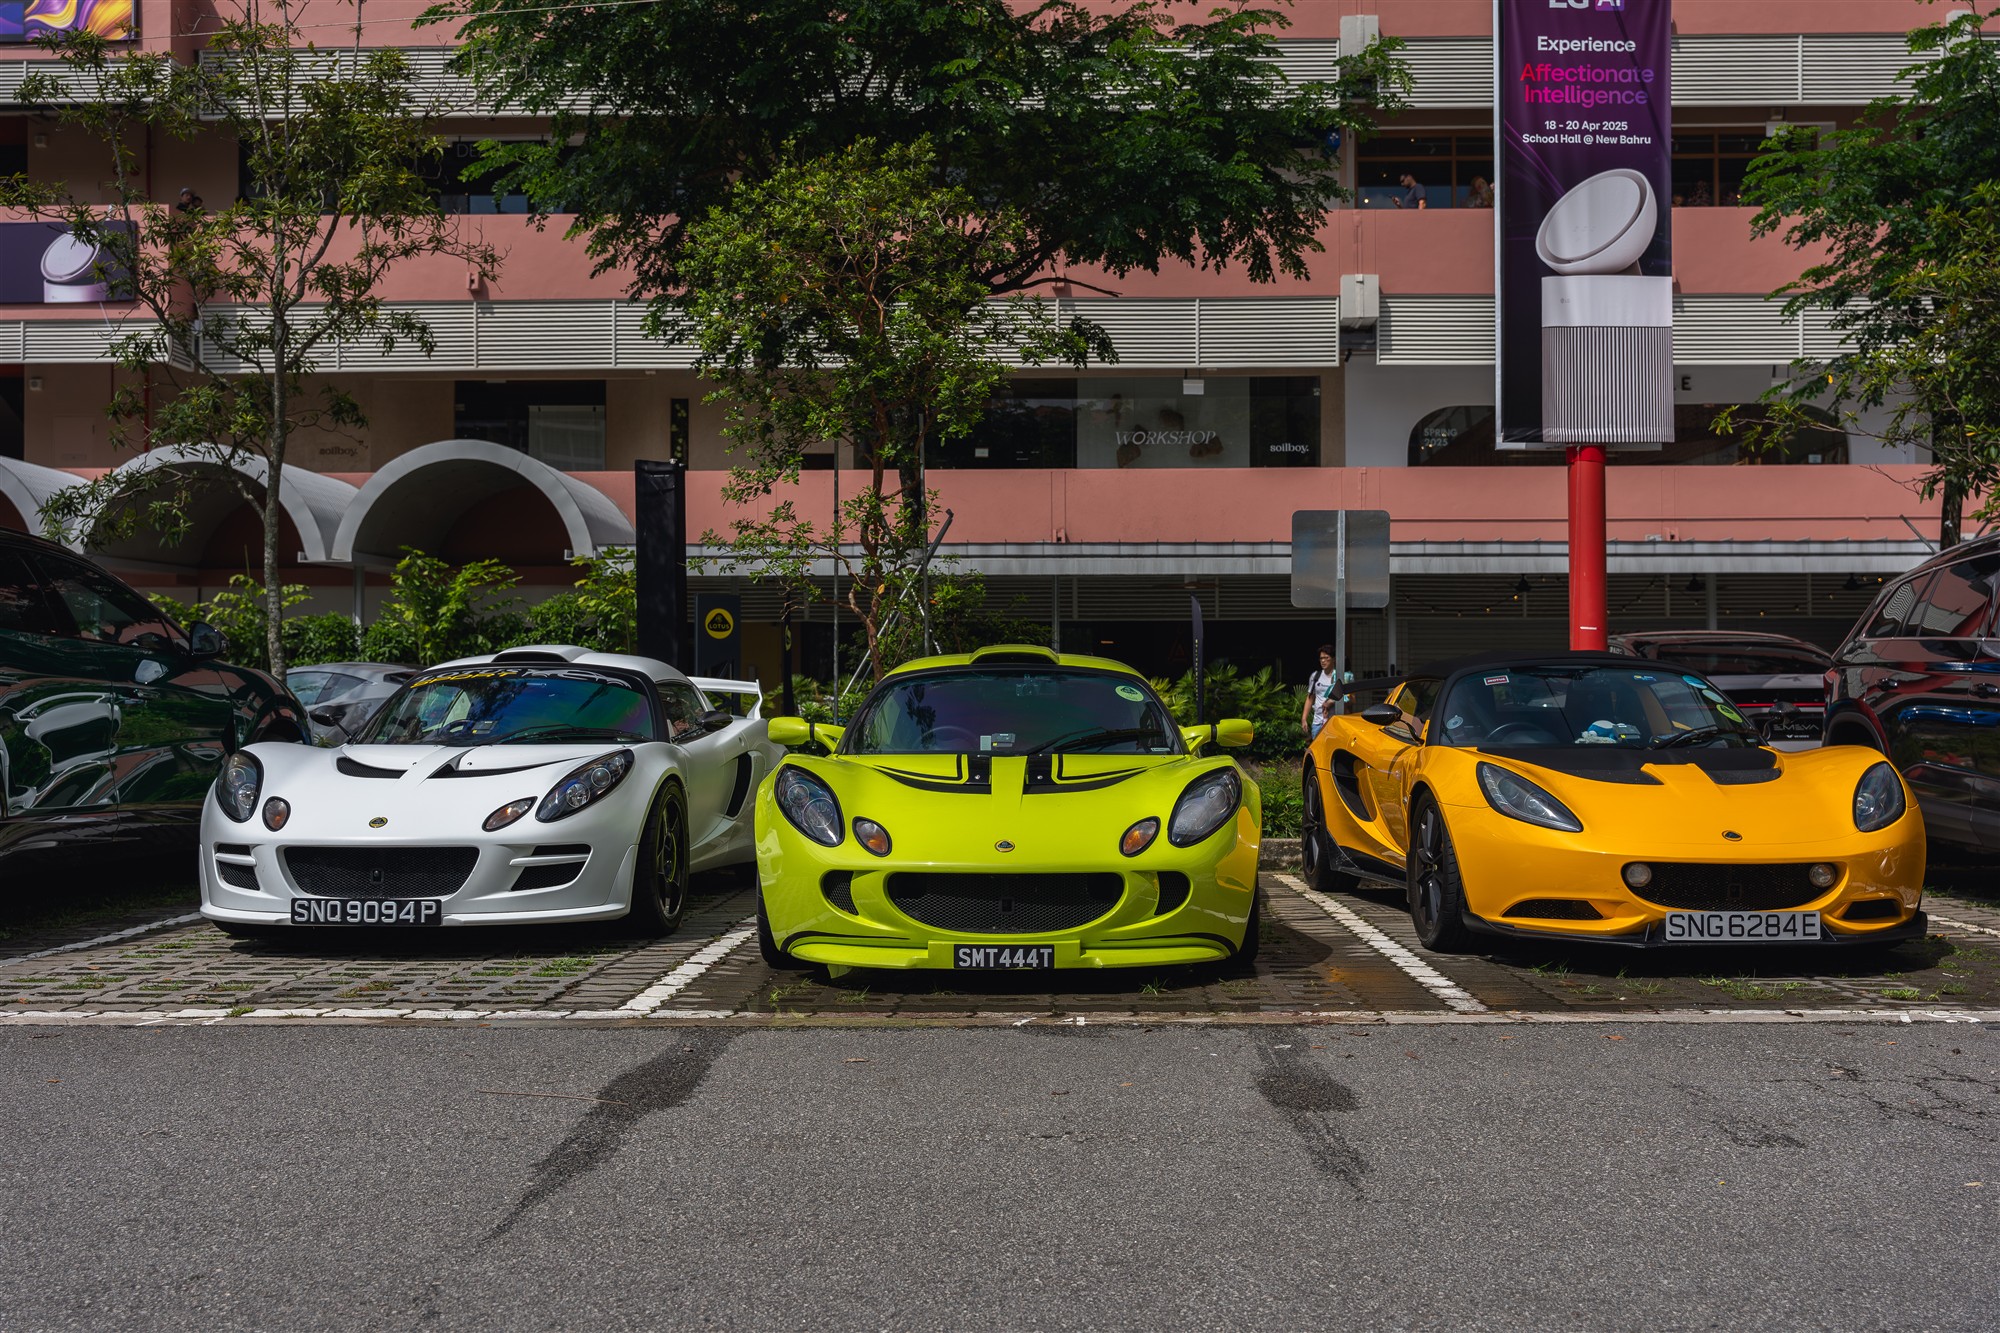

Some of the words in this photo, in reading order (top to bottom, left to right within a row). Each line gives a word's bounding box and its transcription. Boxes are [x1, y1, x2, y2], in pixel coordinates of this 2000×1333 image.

[1537, 36, 1636, 54] Experience
[1520, 63, 1655, 83] Affectionate
[1524, 84, 1649, 109] Intelligence
[1544, 121, 1556, 130] 18
[1566, 121, 1579, 130] 20
[1581, 121, 1600, 132] Apr
[1602, 121, 1628, 131] 2025
[1522, 134, 1558, 144] School
[1560, 134, 1581, 144] Hall
[1583, 135, 1594, 145] @
[1595, 135, 1617, 144] New
[1619, 135, 1651, 144] Bahru
[1115, 430, 1216, 446] WORKSHOP
[1423, 428, 1458, 437] SPRING
[1269, 443, 1309, 454] soilboy.
[1424, 438, 1448, 447] 2025
[958, 947, 1053, 967] SMT444T
